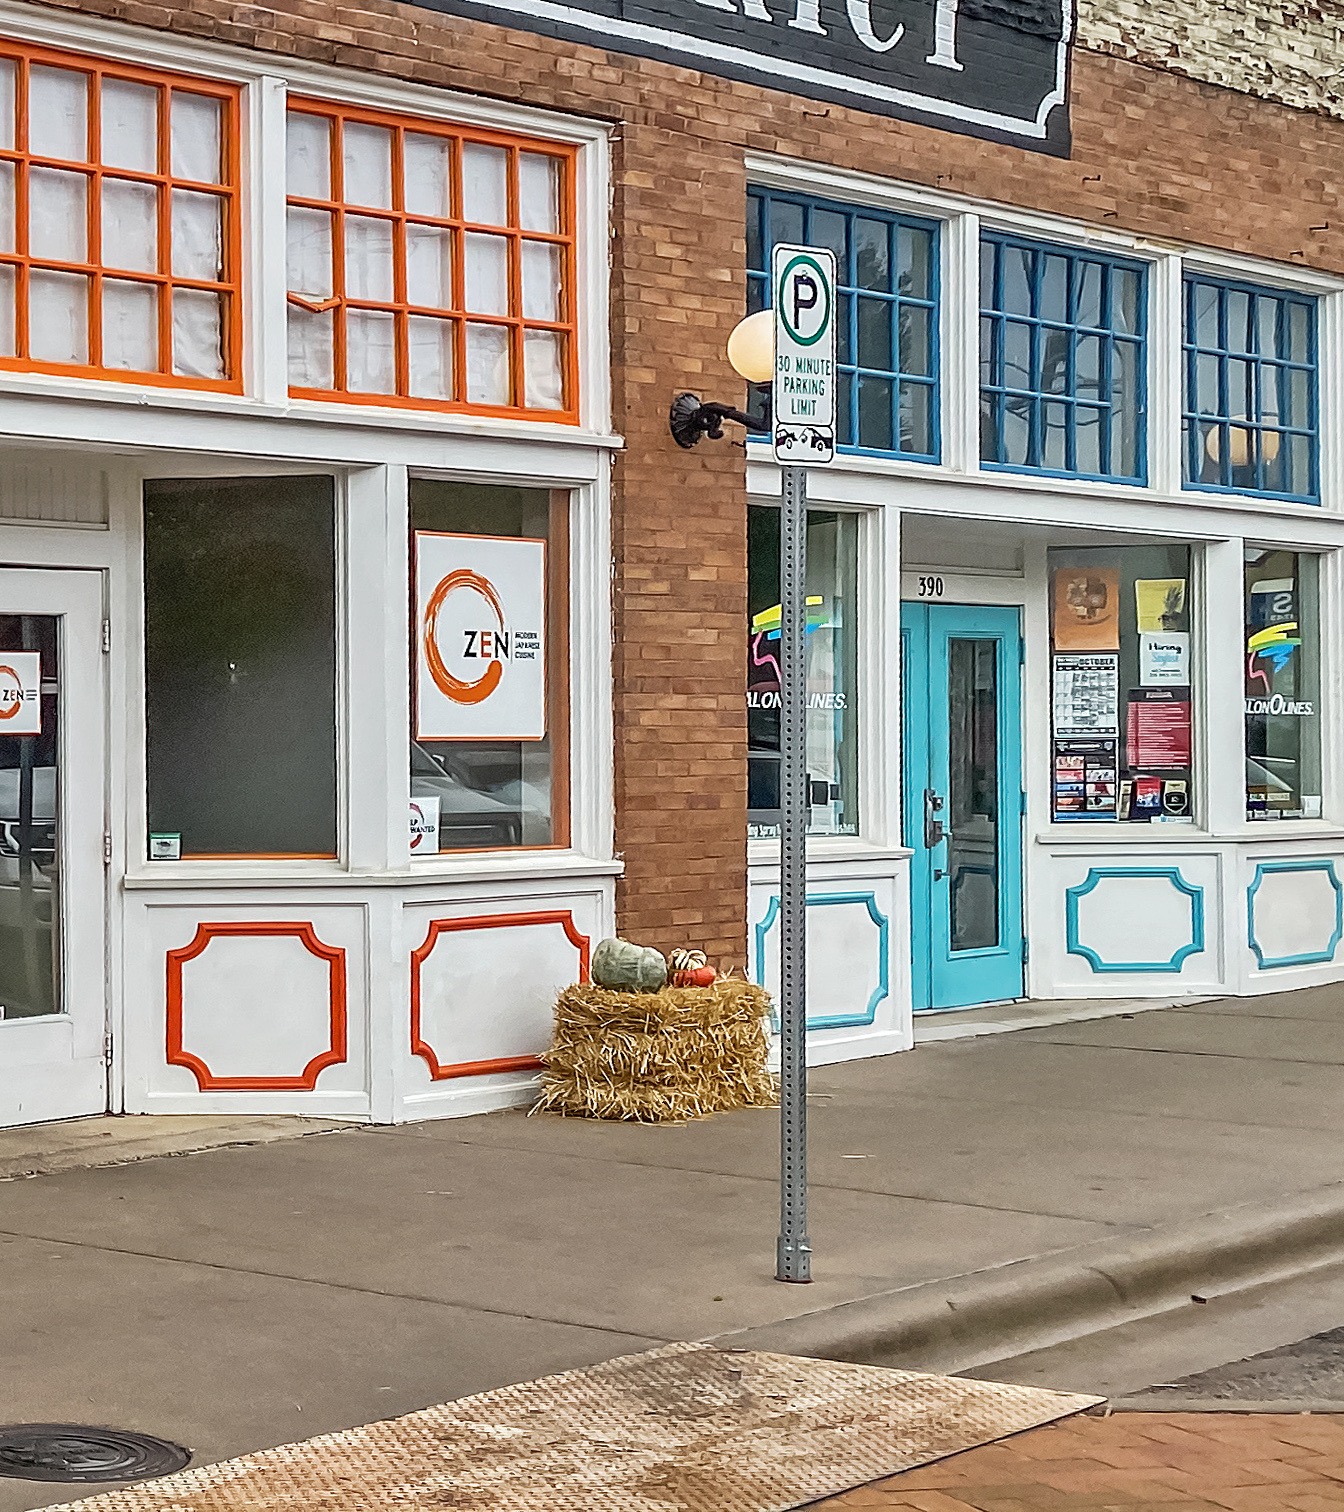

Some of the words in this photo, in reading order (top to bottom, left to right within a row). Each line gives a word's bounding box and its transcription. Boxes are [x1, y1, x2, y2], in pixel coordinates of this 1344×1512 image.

[794, 274, 817, 330] P
[778, 355, 791, 372] 30
[795, 357, 831, 376] MINUTE
[784, 376, 825, 396] PARKING
[791, 398, 817, 416] LIMIT
[918, 576, 944, 597] 390
[463, 630, 510, 659] ZEN
[2, 689, 25, 701] ZEN
